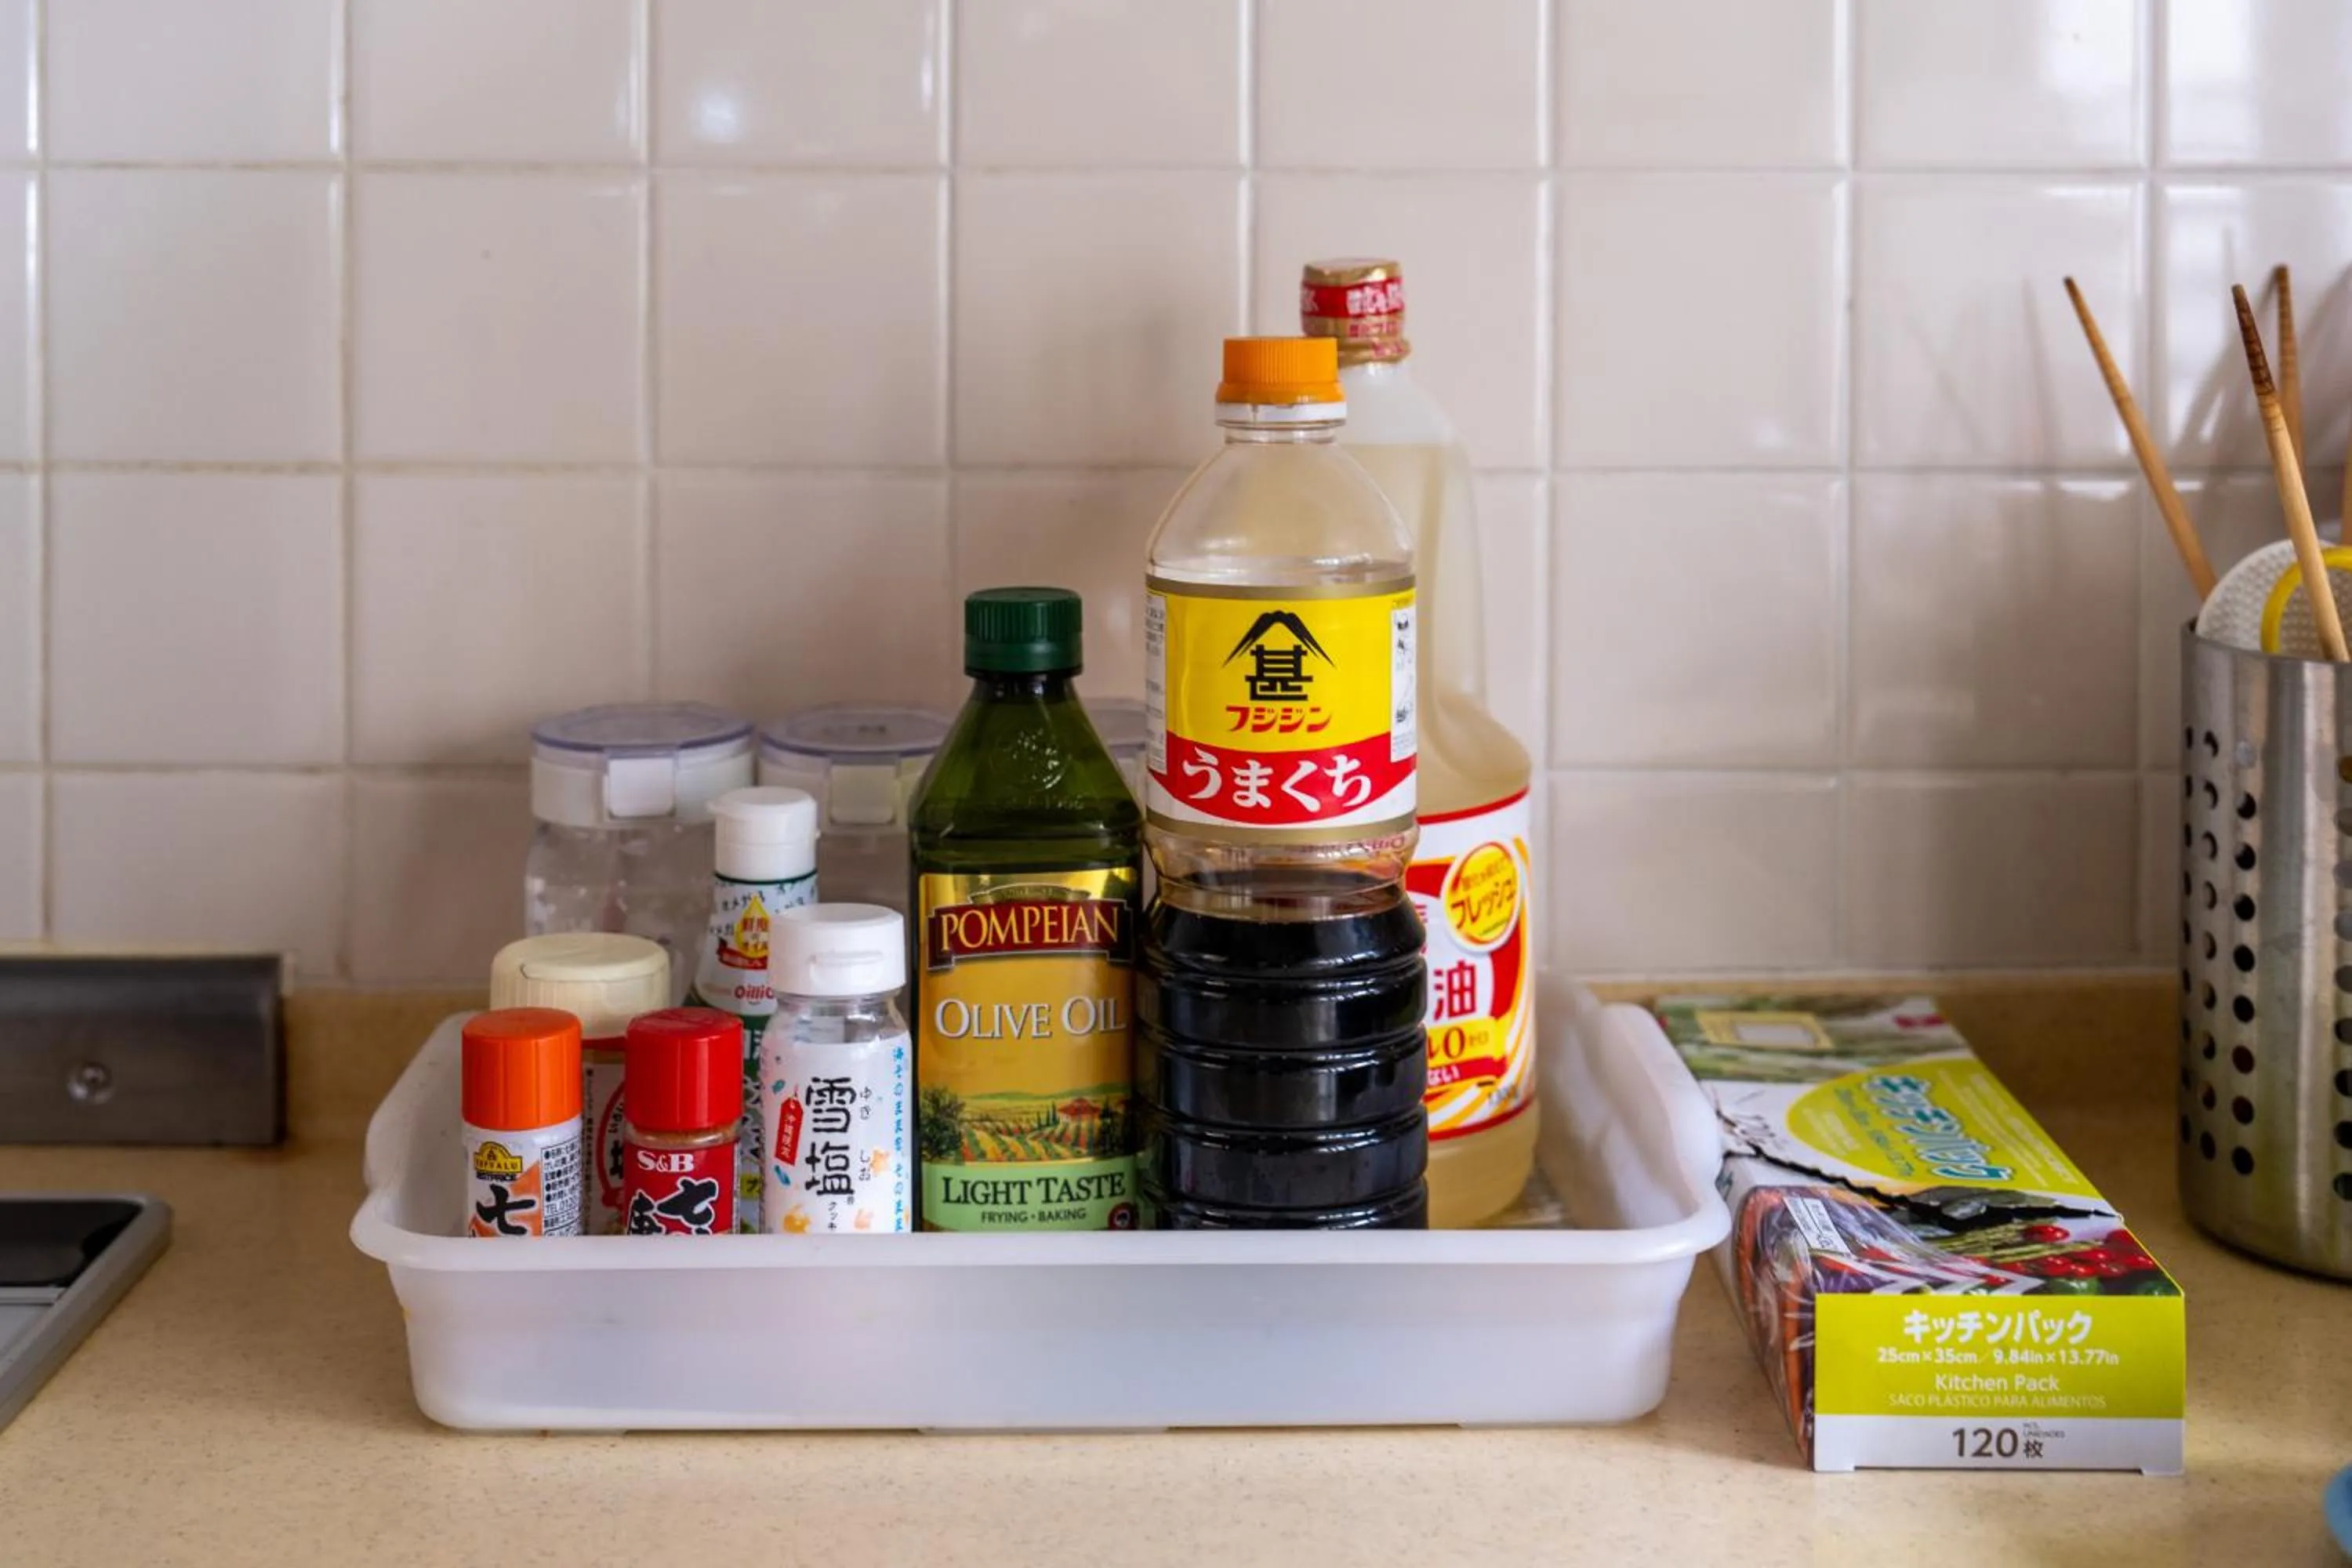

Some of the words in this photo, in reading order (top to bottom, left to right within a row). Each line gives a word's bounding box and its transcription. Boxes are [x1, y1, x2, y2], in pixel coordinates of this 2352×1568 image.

[1225, 705, 1333, 734] フジジン
[1181, 746, 1373, 813] うまくち
[1450, 878, 1517, 930] フレッシュ
[941, 905, 1120, 952] POMPEIAN
[935, 998, 1053, 1040] OLIVE
[1062, 995, 1127, 1035] OIL
[804, 1076, 857, 1196] 雪塩
[636, 1149, 695, 1173] S&B
[942, 1176, 1033, 1205] LIGHT
[1036, 1172, 1126, 1203] TASTE
[981, 1210, 1029, 1225] FRYING
[1037, 1207, 1087, 1223] BAKING
[1903, 1308, 2092, 1345] キッチンパック
[1935, 1373, 2008, 1392] Kitchen
[2015, 1374, 2060, 1392] Pack
[1889, 1394, 1925, 1408] SACO
[1994, 1394, 2028, 1408] PARA
[2031, 1394, 2107, 1409] ALIMENTOS
[1952, 1428, 2019, 1457] 120
[2023, 1439, 2044, 1459] 枚
